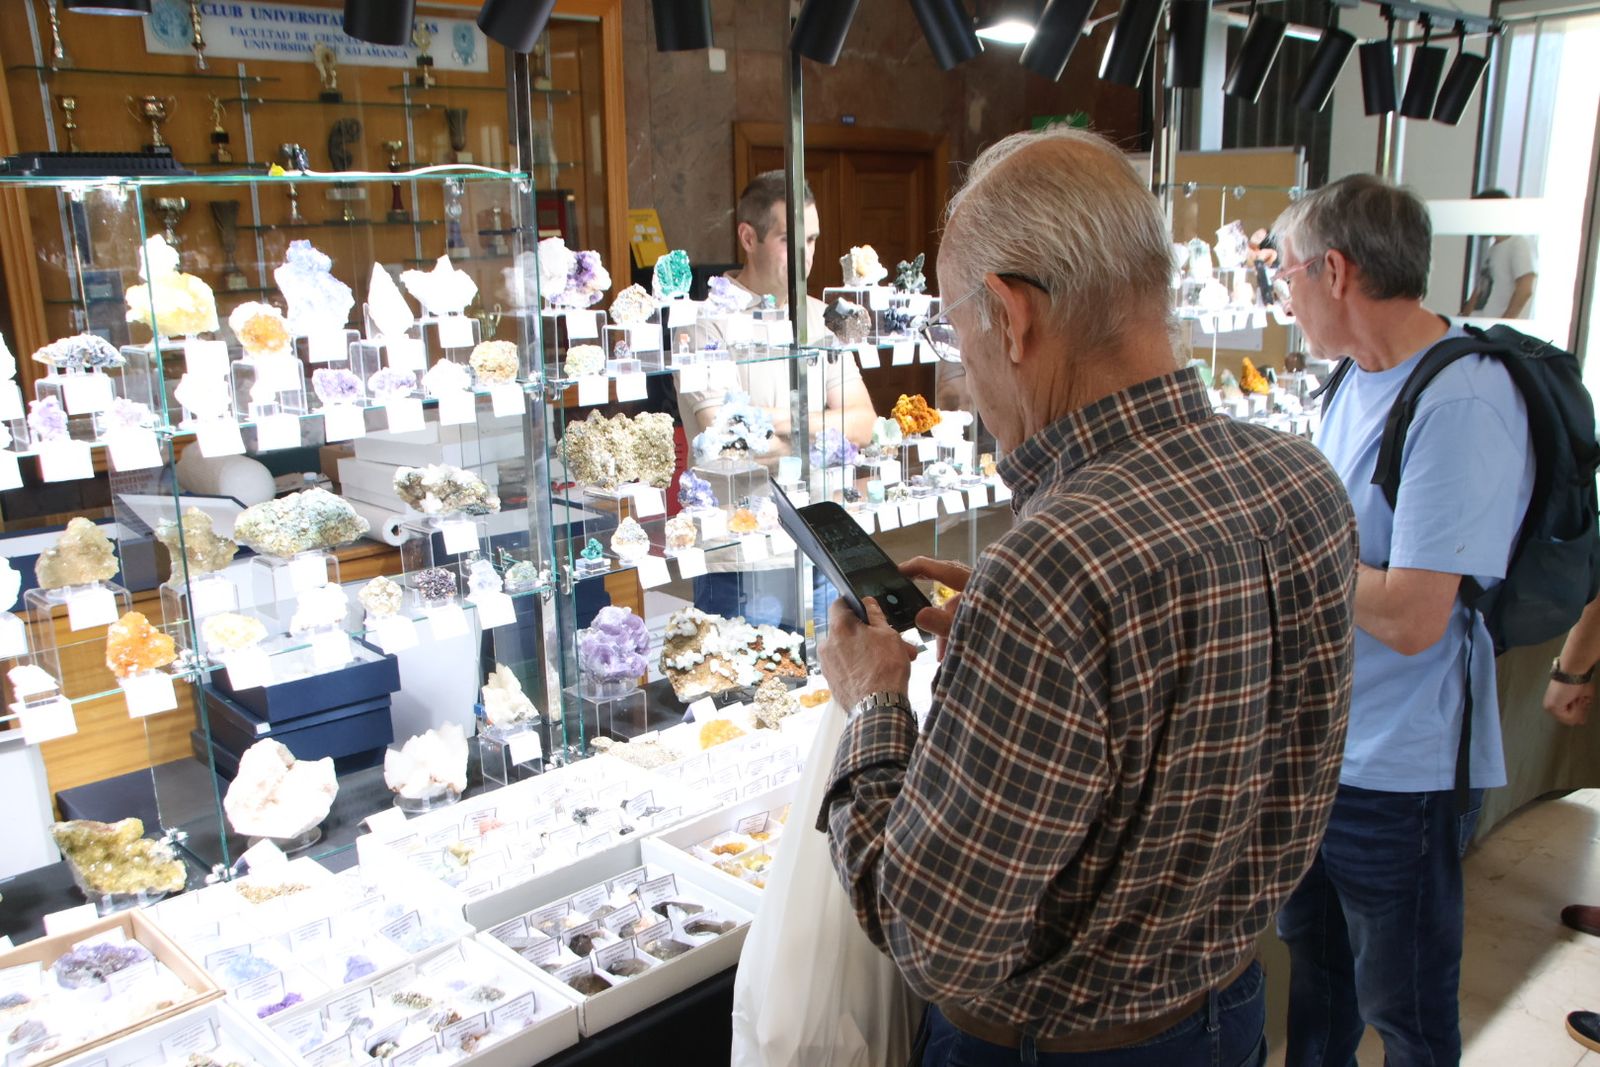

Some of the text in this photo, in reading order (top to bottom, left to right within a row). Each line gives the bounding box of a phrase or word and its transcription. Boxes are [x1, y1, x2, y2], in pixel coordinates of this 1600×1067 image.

[200, 3, 243, 18] CLUB
[229, 25, 291, 39] FACULTAD
[294, 31, 310, 41] DE
[345, 46, 409, 59] SALAMANCA
